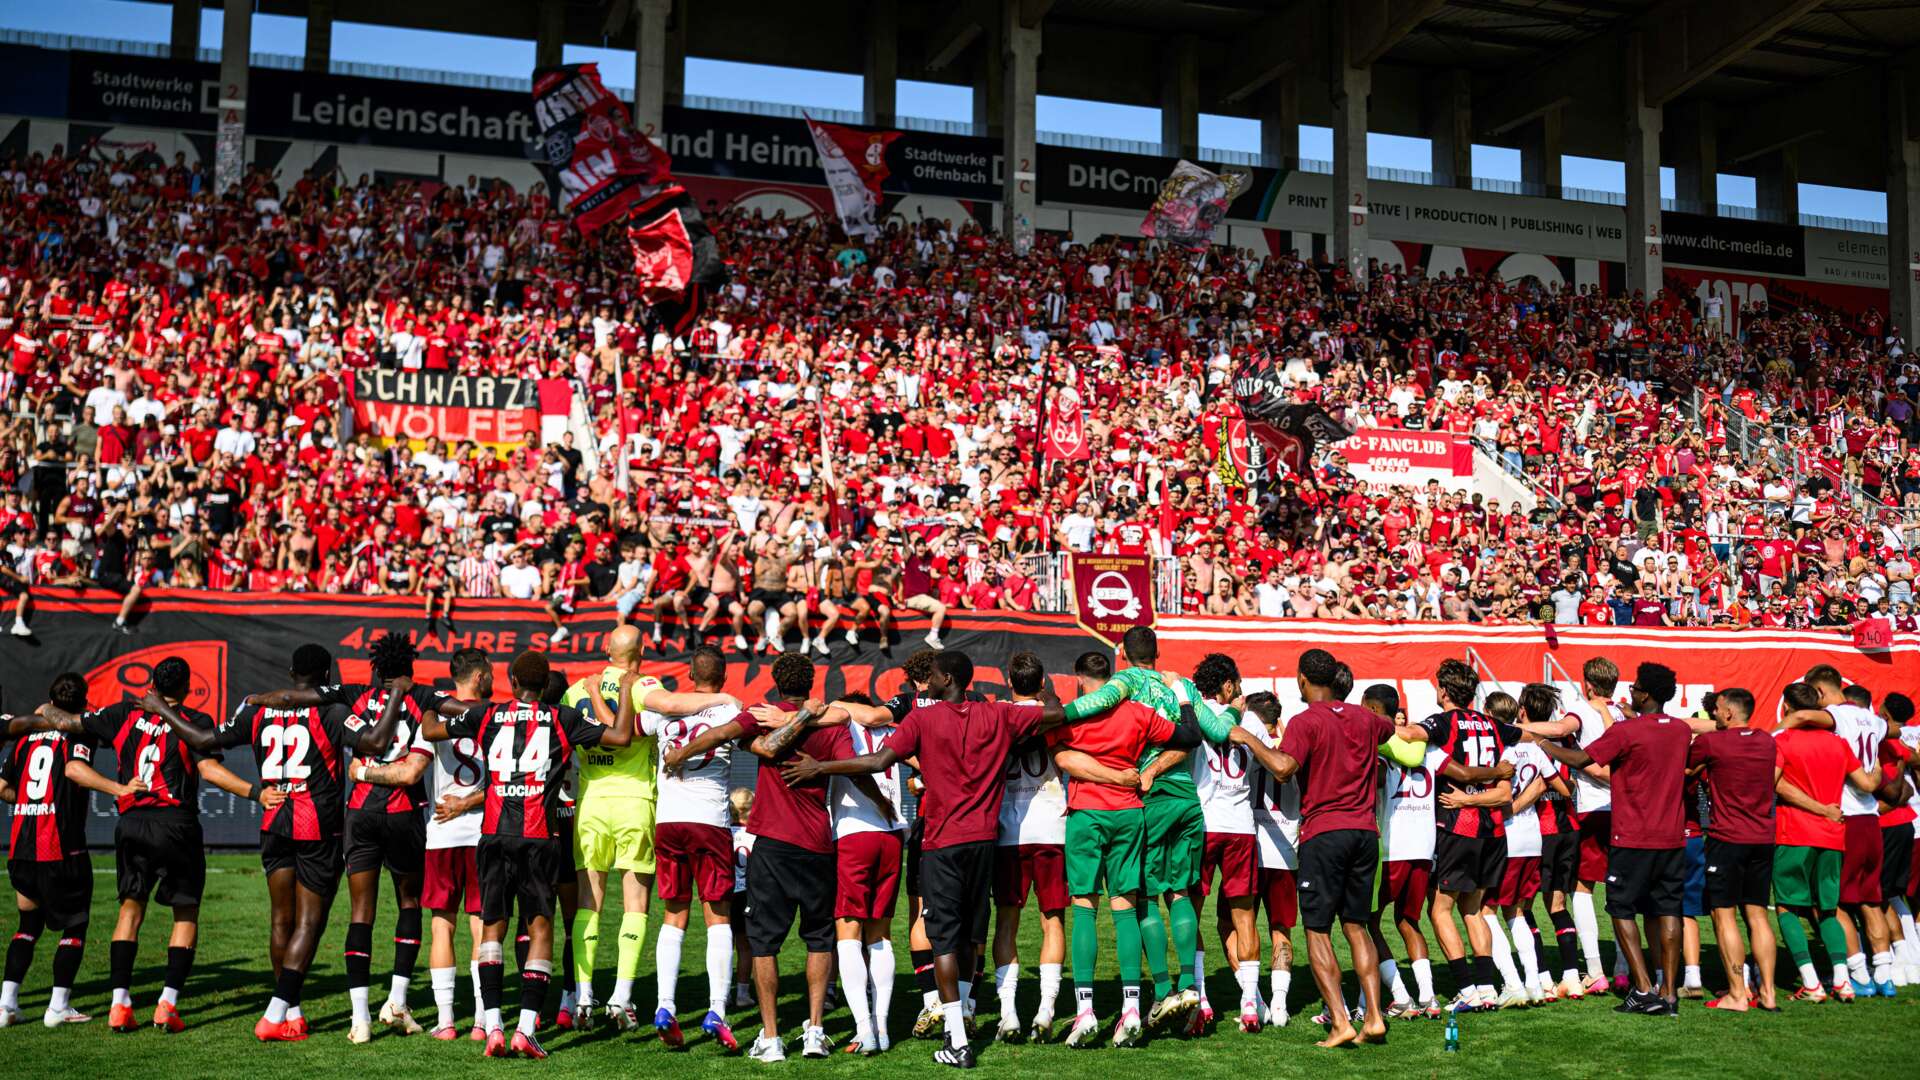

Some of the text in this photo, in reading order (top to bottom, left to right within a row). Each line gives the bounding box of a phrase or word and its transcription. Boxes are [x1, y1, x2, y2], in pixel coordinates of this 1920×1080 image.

[92, 70, 193, 94] Stadtwerke
[227, 84, 239, 98] 2
[102, 91, 192, 113] Offenbach
[224, 109, 239, 123] A
[292, 92, 545, 149] Leidenschaft,
[905, 147, 987, 167] Stadtwerke
[1020, 158, 1030, 172] 2
[913, 164, 986, 184] Offenbach
[1019, 180, 1031, 194] C
[1354, 193, 1362, 206] 2
[1288, 193, 1328, 209] PRINT
[1414, 207, 1498, 227] PRODUCTION
[1511, 216, 1584, 236] PUBLISHING
[1596, 226, 1622, 240] WEB
[1353, 213, 1364, 226] D
[1649, 223, 1658, 237] 3
[1648, 246, 1659, 256] A
[1662, 231, 1888, 258] www.dhc-media.de elemen
[357, 366, 524, 409] SCHWARZ
[367, 402, 525, 443] WÖLFE
[1053, 428, 1079, 445] 04
[1244, 468, 1271, 484] 04
[1858, 630, 1882, 646] 240
[494, 710, 552, 723] BAYER 04
[261, 723, 311, 780] 22
[488, 725, 552, 782] 44
[453, 737, 481, 786] 8
[26, 745, 54, 800] 9
[494, 784, 545, 797] ELOCIAN
[1394, 803, 1421, 812] NanoRepro
